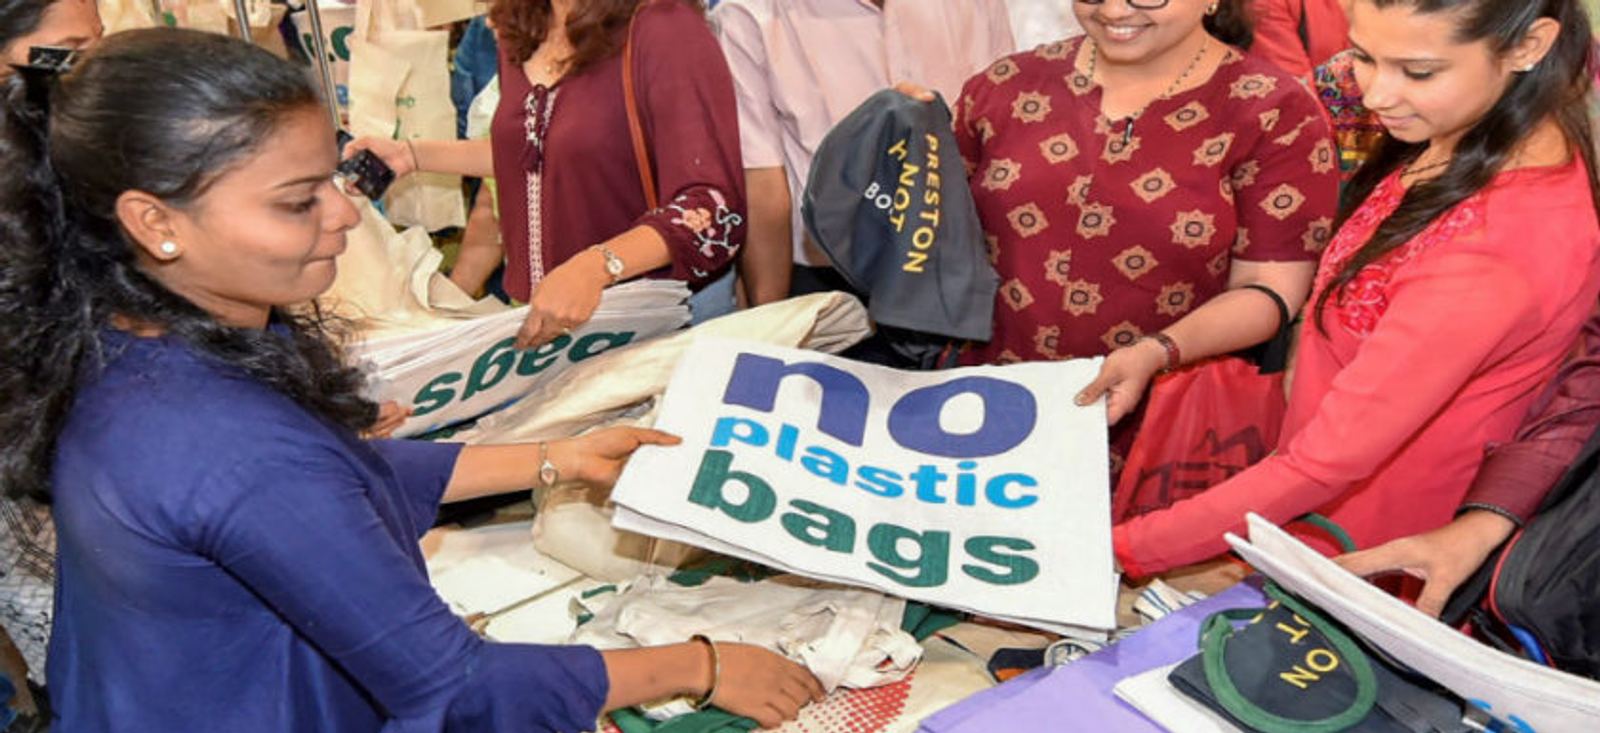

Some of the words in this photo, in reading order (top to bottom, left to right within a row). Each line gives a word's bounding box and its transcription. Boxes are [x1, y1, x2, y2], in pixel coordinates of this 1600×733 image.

[864, 181, 894, 216] BO
[888, 161, 920, 233] NOT
[902, 133, 942, 273] PRESTON
[722, 352, 1038, 459] no
[710, 416, 1039, 510] plastic
[687, 449, 1040, 588] bags
